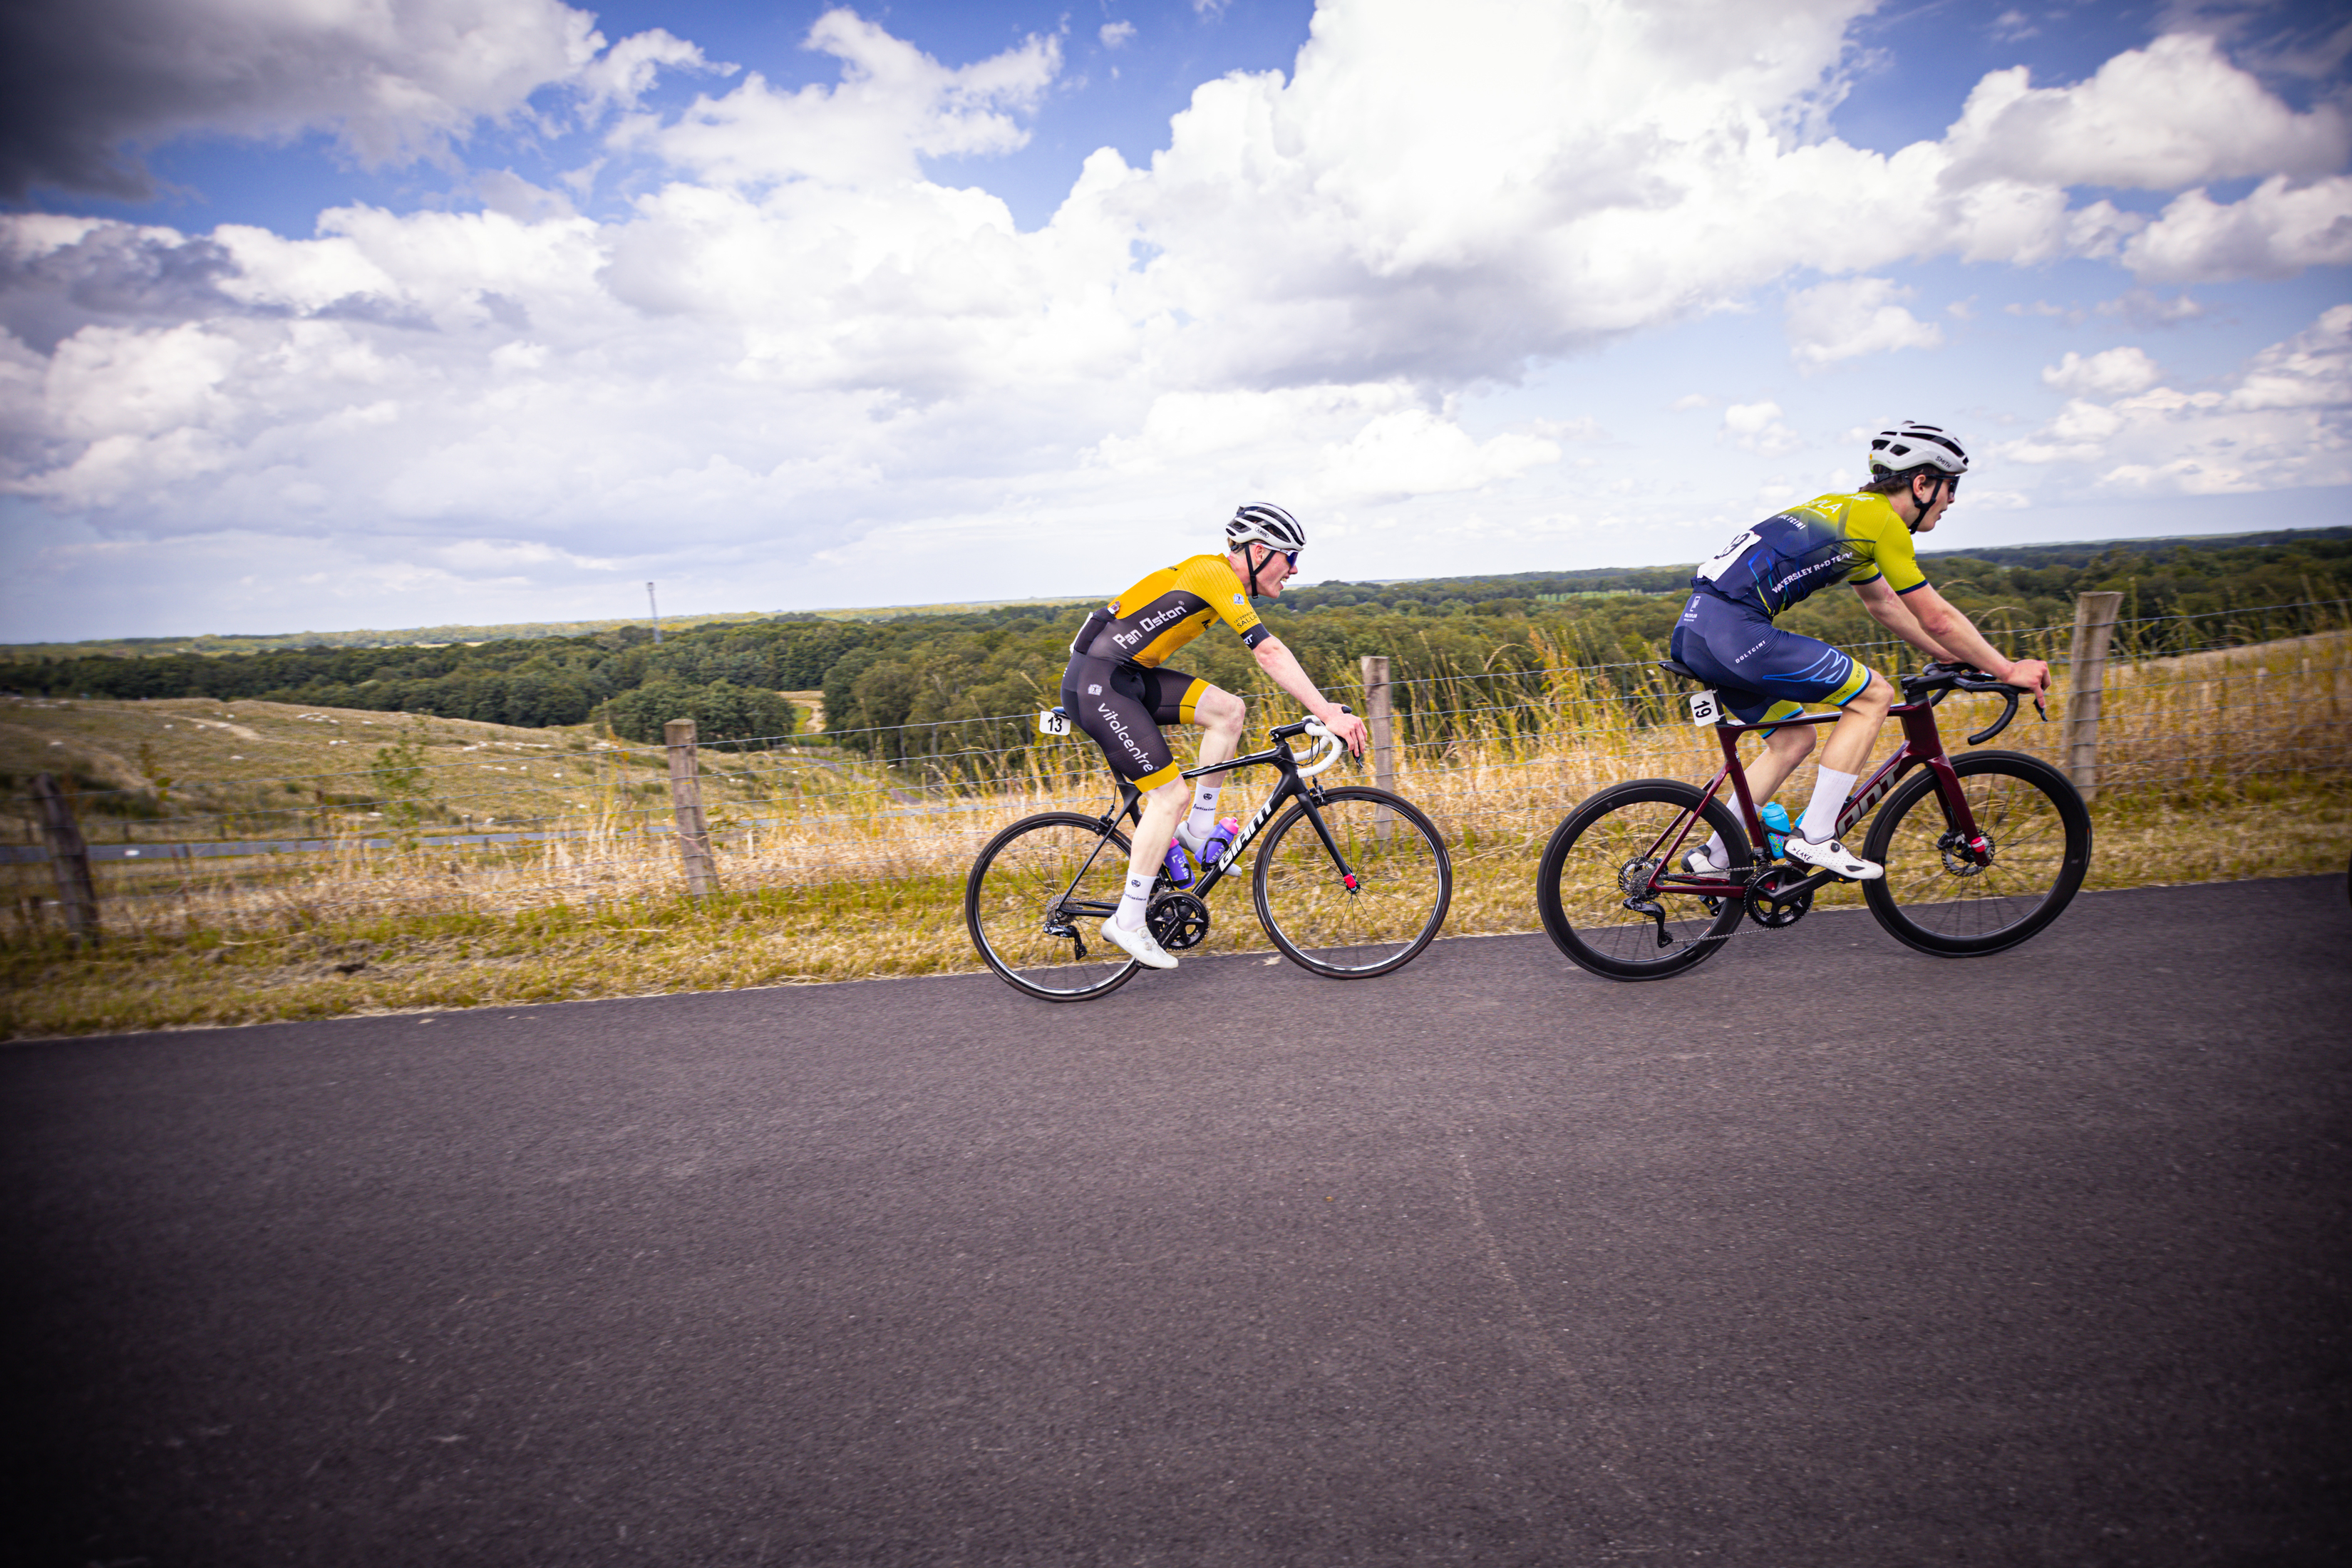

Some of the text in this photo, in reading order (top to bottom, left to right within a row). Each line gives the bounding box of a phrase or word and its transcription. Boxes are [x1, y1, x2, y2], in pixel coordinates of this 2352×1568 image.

[1935, 455, 1952, 469] SMITH
[1257, 528, 1268, 537] ABUS
[1772, 552, 1853, 594] WATERSLEY R+D TEAM
[1112, 629, 1143, 649] Pan
[1735, 640, 1766, 664] DOLTCINI
[1693, 700, 1712, 718] 19
[1048, 716, 1063, 733] 13
[1098, 703, 1154, 773] vitalcentre
[1219, 793, 1274, 872] GIANT
[1795, 849, 1813, 862] LAKE
